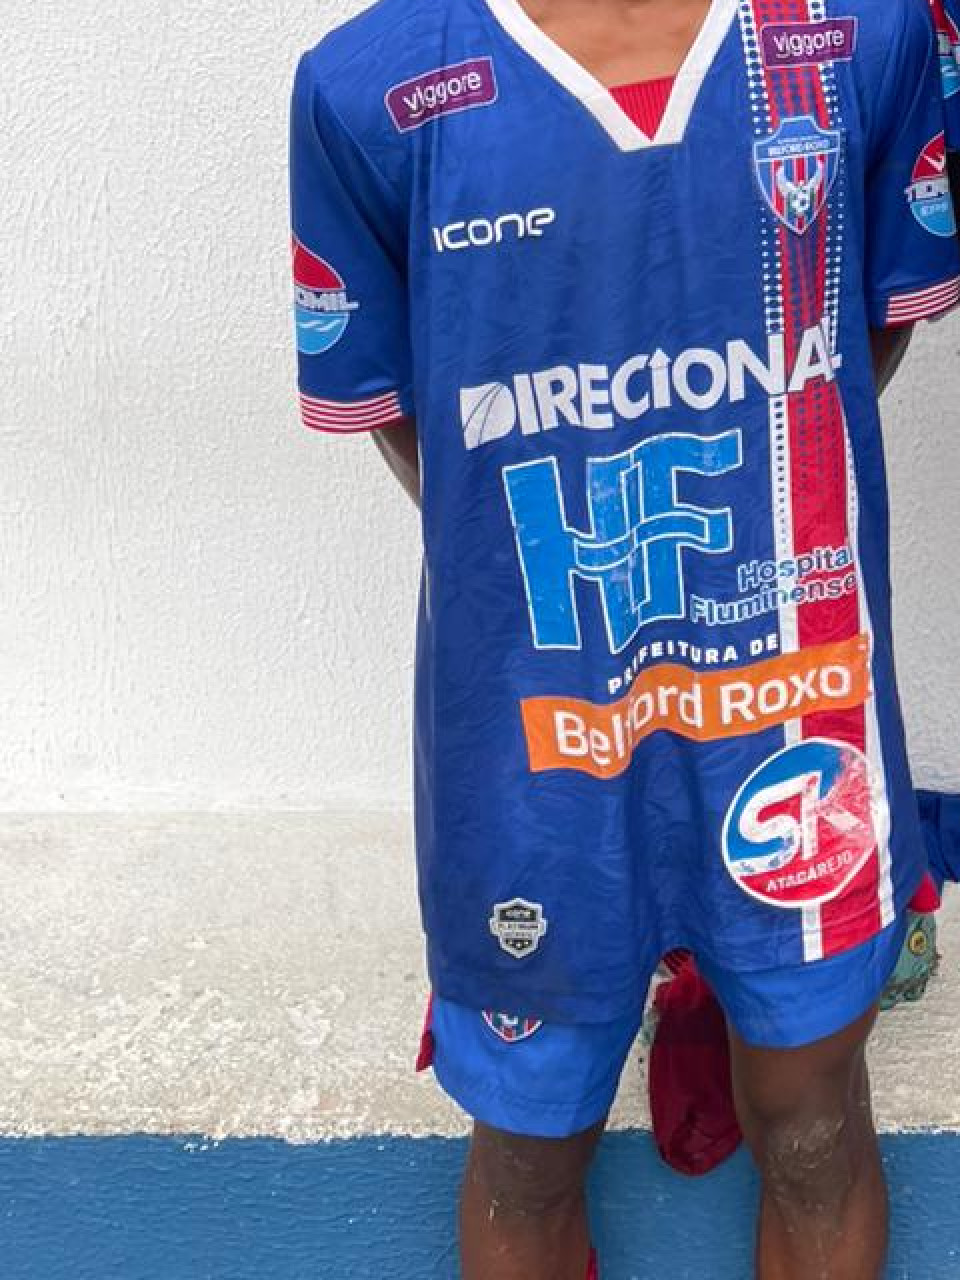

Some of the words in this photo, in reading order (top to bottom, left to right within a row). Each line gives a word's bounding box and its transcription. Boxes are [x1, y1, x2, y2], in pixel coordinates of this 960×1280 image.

[772, 26, 845, 60] viggore
[401, 66, 483, 118] viggore
[737, 545, 854, 593] Hospita
[690, 572, 857, 627] Fluminense
[750, 633, 778, 656] DE
[720, 665, 851, 724] Roxo
